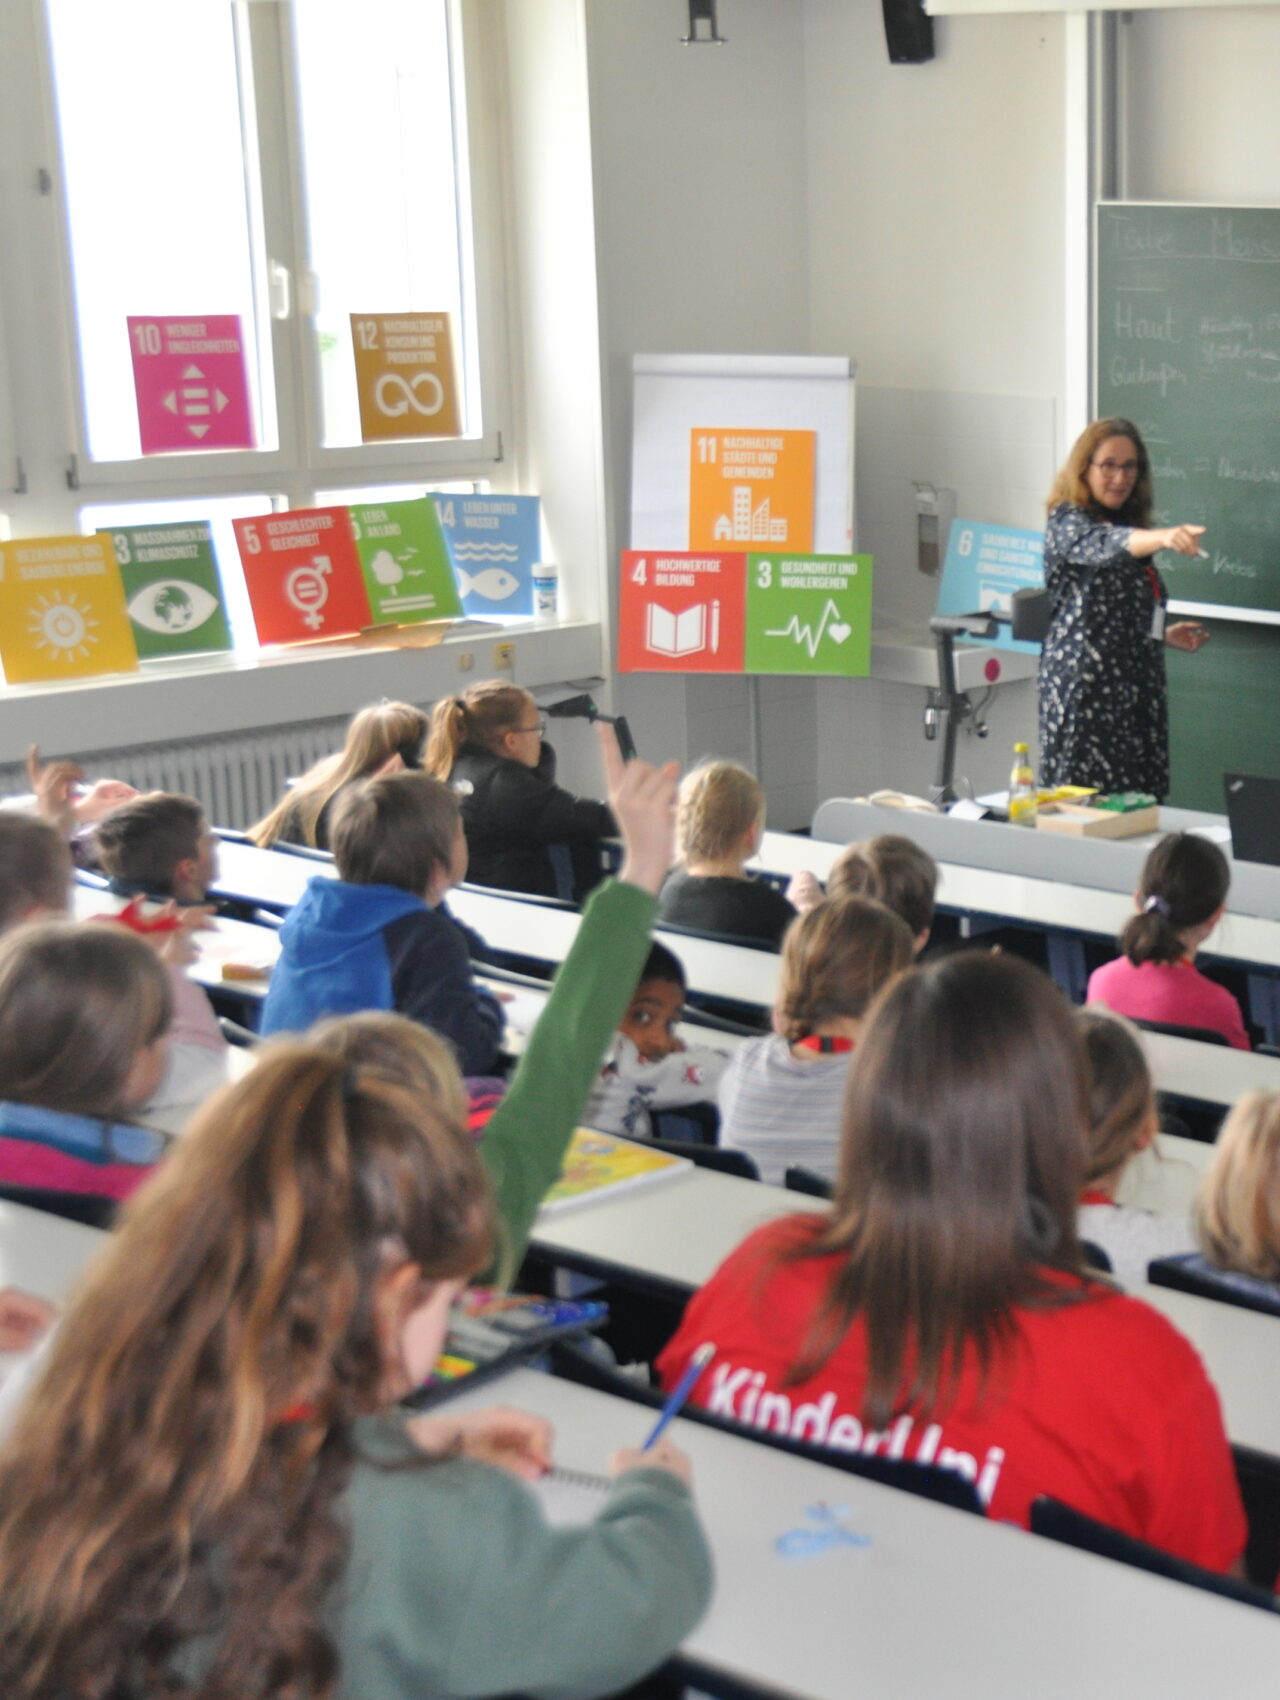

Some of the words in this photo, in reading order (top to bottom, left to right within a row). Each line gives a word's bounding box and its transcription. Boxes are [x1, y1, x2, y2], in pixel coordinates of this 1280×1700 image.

[135, 324, 163, 357] 10
[357, 320, 380, 351] 12
[698, 436, 717, 464] 11
[722, 436, 784, 451] NACHHALTIGE
[722, 451, 756, 464] STÄDTE
[758, 452, 777, 465] UND
[722, 465, 775, 480] GEMEINDEN
[362, 509, 388, 523] LEBEN
[462, 501, 490, 515] LEBEN
[491, 502, 518, 516] UNTER
[463, 516, 500, 529] WASSER
[133, 530, 197, 546] MASSNAHMEN
[243, 524, 262, 554] 5
[270, 532, 320, 551] GLEICHHEIT
[957, 529, 974, 557] 6
[136, 543, 199, 563] KLIMASCHUTZ
[631, 558, 648, 586] 4
[655, 558, 722, 574] HOCHWERTIGE
[780, 559, 836, 575] GESUNDHEIT
[838, 561, 858, 576] UND
[655, 573, 695, 588] BILDUNG
[756, 560, 773, 589] 3
[779, 575, 849, 590] WOHLERGEHEN
